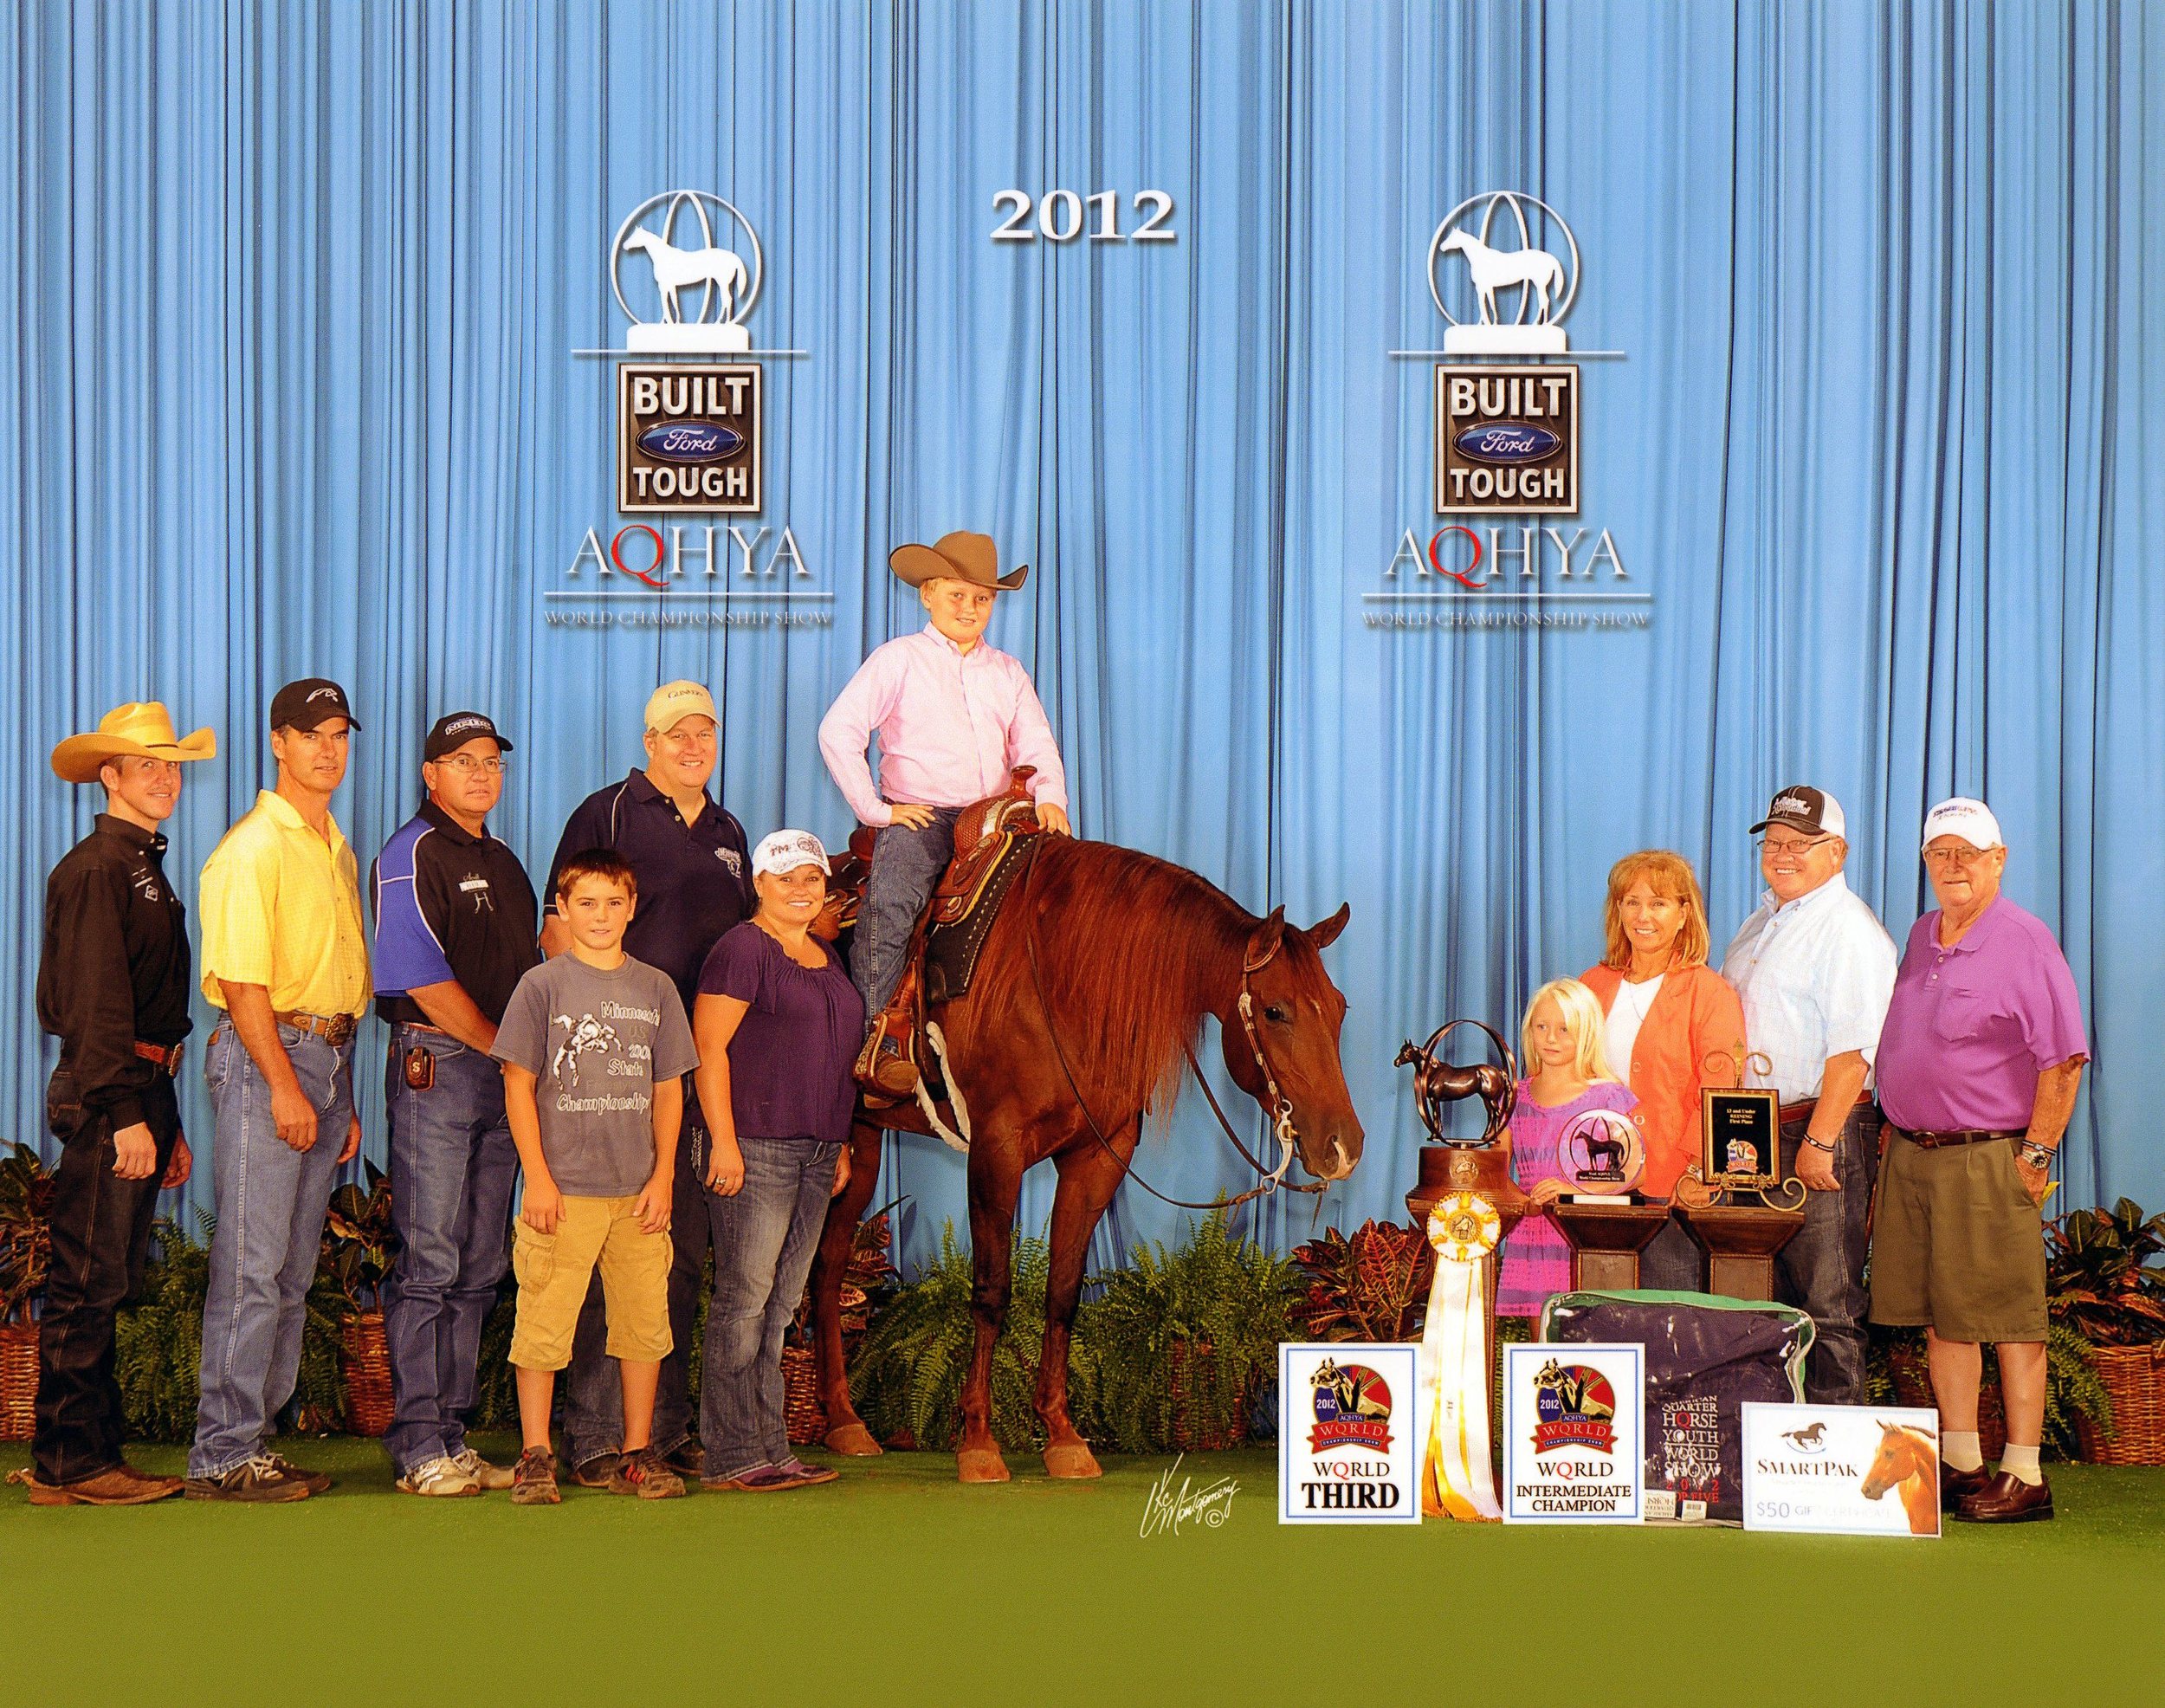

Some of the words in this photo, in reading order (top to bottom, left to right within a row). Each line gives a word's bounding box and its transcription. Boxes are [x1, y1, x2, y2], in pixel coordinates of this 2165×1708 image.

[627, 1044, 651, 1061] 200
[1316, 1398, 1336, 1409] 2012
[1540, 1399, 1559, 1410] 2012
[1662, 1402, 1718, 1413] QUARTER
[1302, 1483, 1399, 1509] THIRD
[1516, 1485, 1632, 1498] INTERMEDIATE
[1532, 1499, 1616, 1511] CHAMPION
[1757, 1502, 1790, 1517] $50
[1794, 1505, 1816, 1516] GIF
